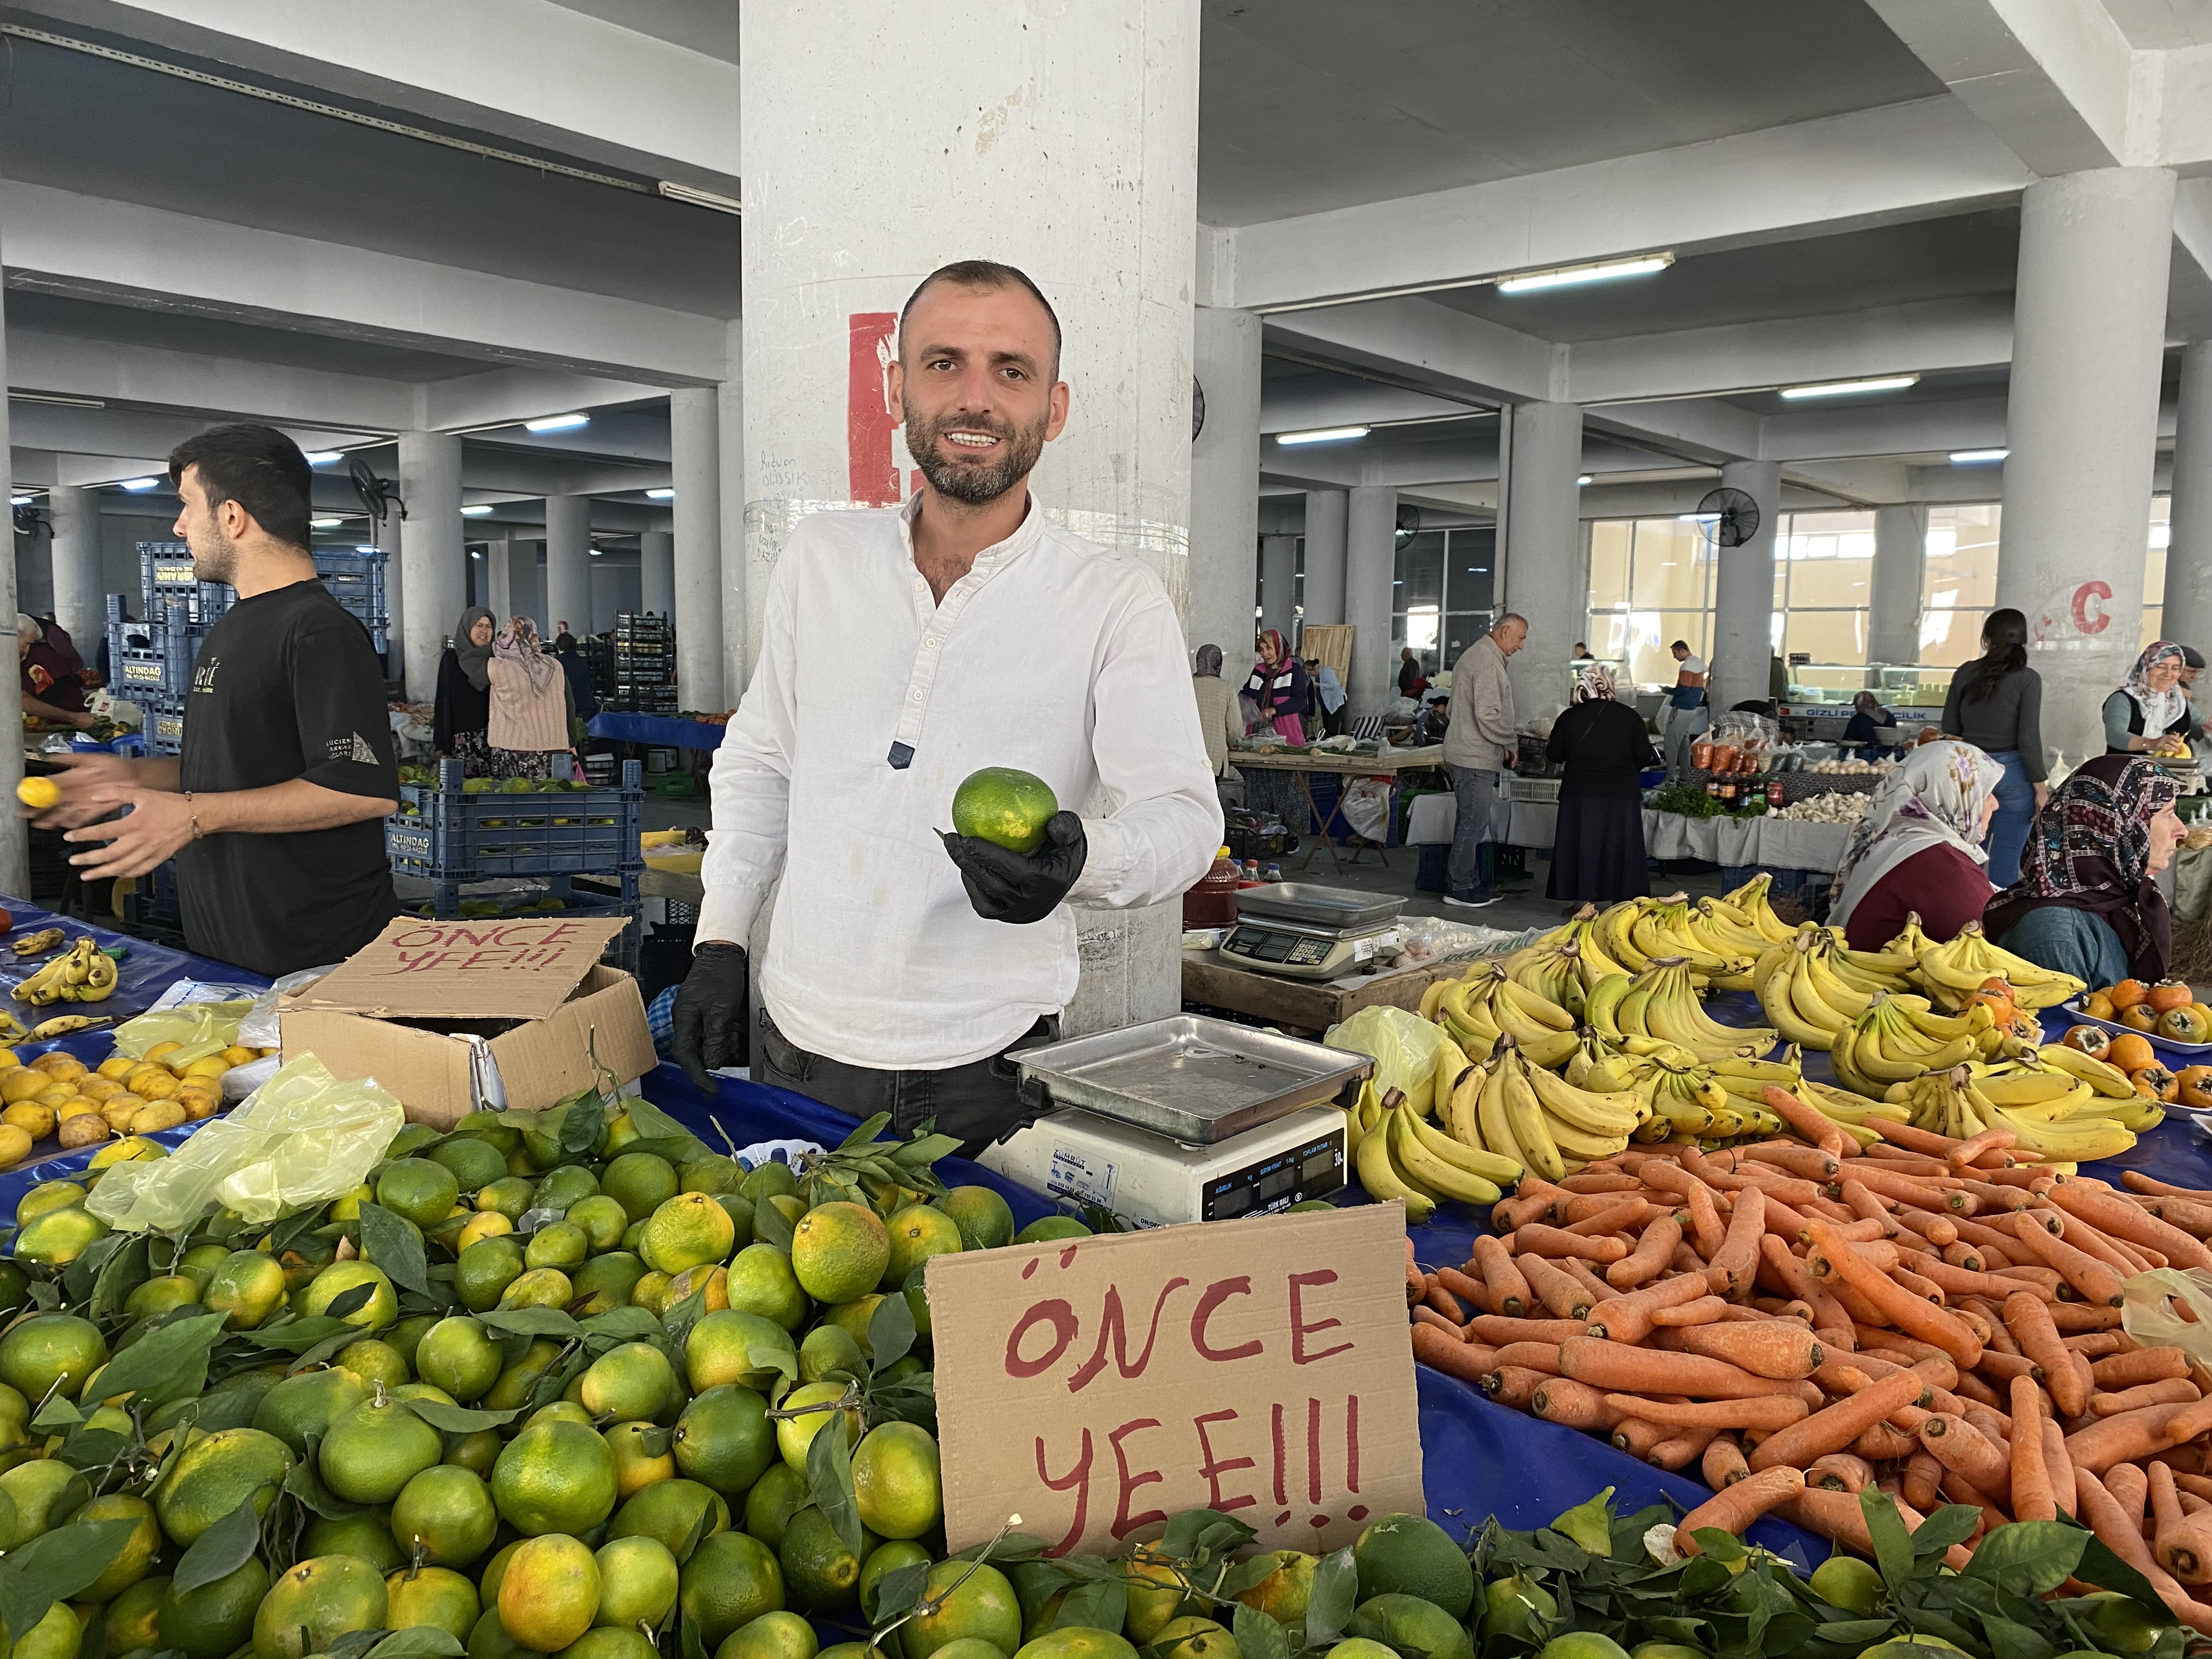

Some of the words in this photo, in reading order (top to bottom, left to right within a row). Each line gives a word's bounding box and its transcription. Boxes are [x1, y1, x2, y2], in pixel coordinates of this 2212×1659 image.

[2071, 581, 2113, 634] C
[125, 665, 162, 676] ALTINDAĞ
[1807, 707, 1837, 716] GİZLİ
[326, 738, 351, 747] LUCIEN
[391, 833, 430, 849] ALTINDAĞ
[388, 923, 588, 947] ÖNCE
[370, 947, 566, 975] YEE!!!
[1053, 1149, 1086, 1165] ZÜMRÜT
[1215, 1182, 1233, 1194] AĞIRLIK
[1268, 1200, 1279, 1211] TÜRK
[1279, 1196, 1289, 1206] MALI
[1004, 1244, 1355, 1393] ÖNCE
[1035, 1395, 1370, 1559] YEE!!!
